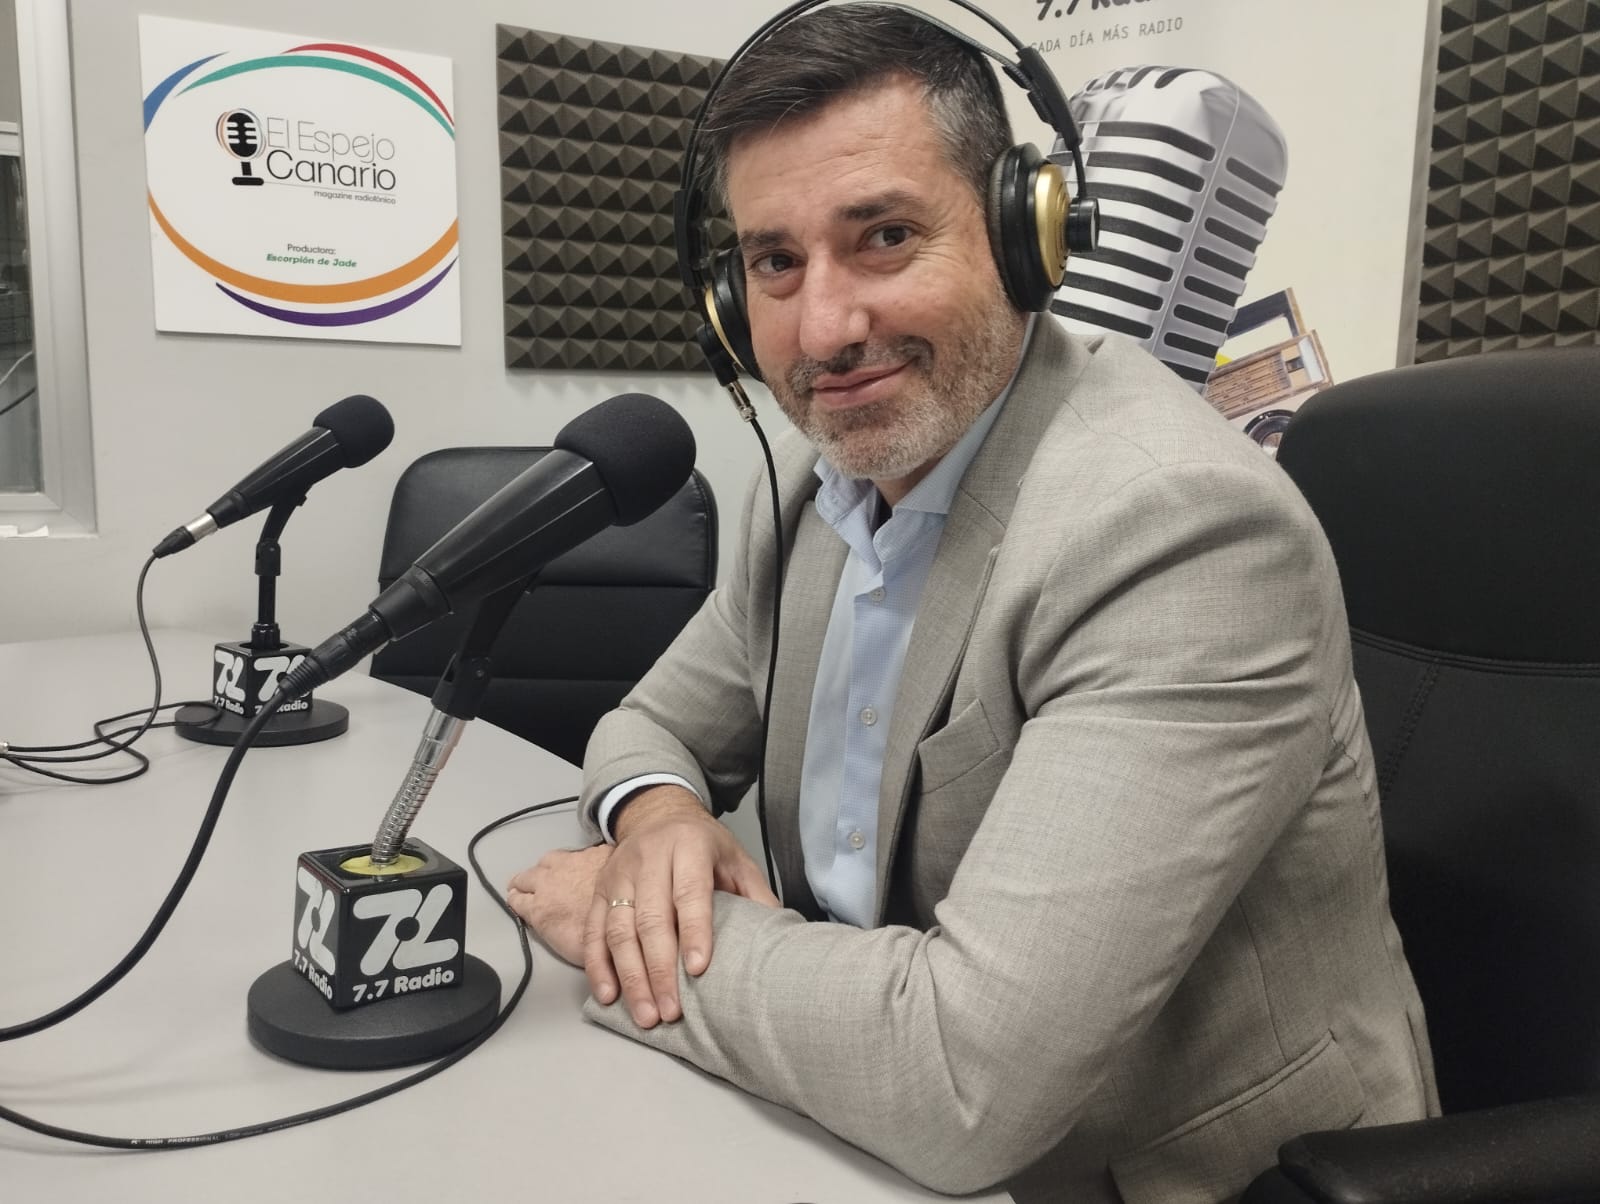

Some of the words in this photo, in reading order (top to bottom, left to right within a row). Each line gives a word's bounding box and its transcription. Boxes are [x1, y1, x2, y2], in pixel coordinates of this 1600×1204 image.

[1070, 31, 1094, 48] DÍA
[1103, 24, 1129, 42] MÁS
[1139, 17, 1183, 36] RADIO
[267, 117, 290, 149] El
[298, 121, 396, 163] Espejo
[266, 150, 396, 190] Canario
[314, 191, 353, 199] magazine
[266, 253, 314, 265] Escorpión
[317, 257, 330, 265] de
[332, 258, 357, 268] Jade
[287, 243, 336, 255] Productora:
[294, 949, 308, 974] 7.7
[308, 963, 333, 1000] Radio
[352, 979, 390, 1002] 7.7
[394, 967, 455, 993] Radio
